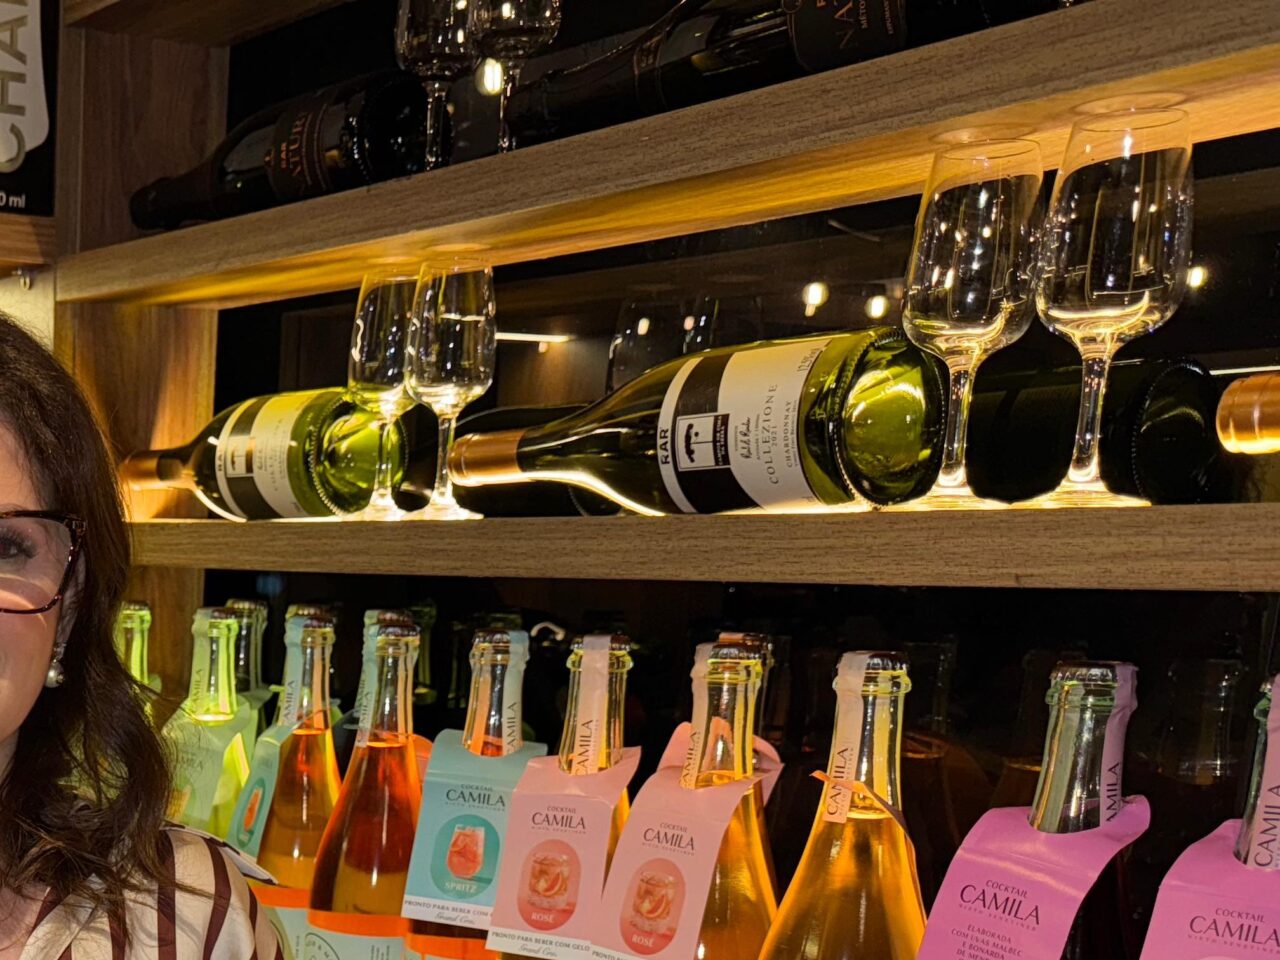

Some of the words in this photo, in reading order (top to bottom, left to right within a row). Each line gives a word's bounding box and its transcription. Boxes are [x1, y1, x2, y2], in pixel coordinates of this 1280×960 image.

[8, 192, 26, 208] ml
[761, 384, 780, 485] COLLEZIONE
[782, 400, 793, 468] CHARDONNAY
[660, 427, 671, 465] RAR
[574, 719, 594, 776] CAMILA
[446, 788, 506, 808] CAMILA
[547, 805, 577, 815] COCKTAIL
[531, 811, 587, 830] CAMILA
[660, 822, 688, 833] COCKTAIL
[643, 827, 695, 851] CAMILA
[444, 881, 478, 893] SPRITZ
[985, 879, 1029, 899] COCKTAIL
[404, 899, 432, 909] PRONTO
[432, 903, 451, 912] PARA
[451, 906, 472, 915] BEBER
[472, 908, 489, 917] COM
[959, 883, 1040, 925] CAMILA
[531, 910, 555, 923] ROSÉ
[1215, 907, 1266, 924] COCKTAIL
[492, 931, 517, 941] PRONTO
[517, 935, 534, 944] PARA
[534, 937, 554, 947] BEBER
[554, 940, 571, 949] COM
[571, 942, 590, 952] GELO
[631, 934, 656, 948] ROSÉ
[967, 924, 1012, 944] ELABORADA
[1189, 915, 1280, 948] CAMILA
[951, 928, 969, 940] COM
[992, 941, 1023, 957] MALBEC
[969, 942, 1006, 960] BONARDA
[956, 948, 967, 958] DE
